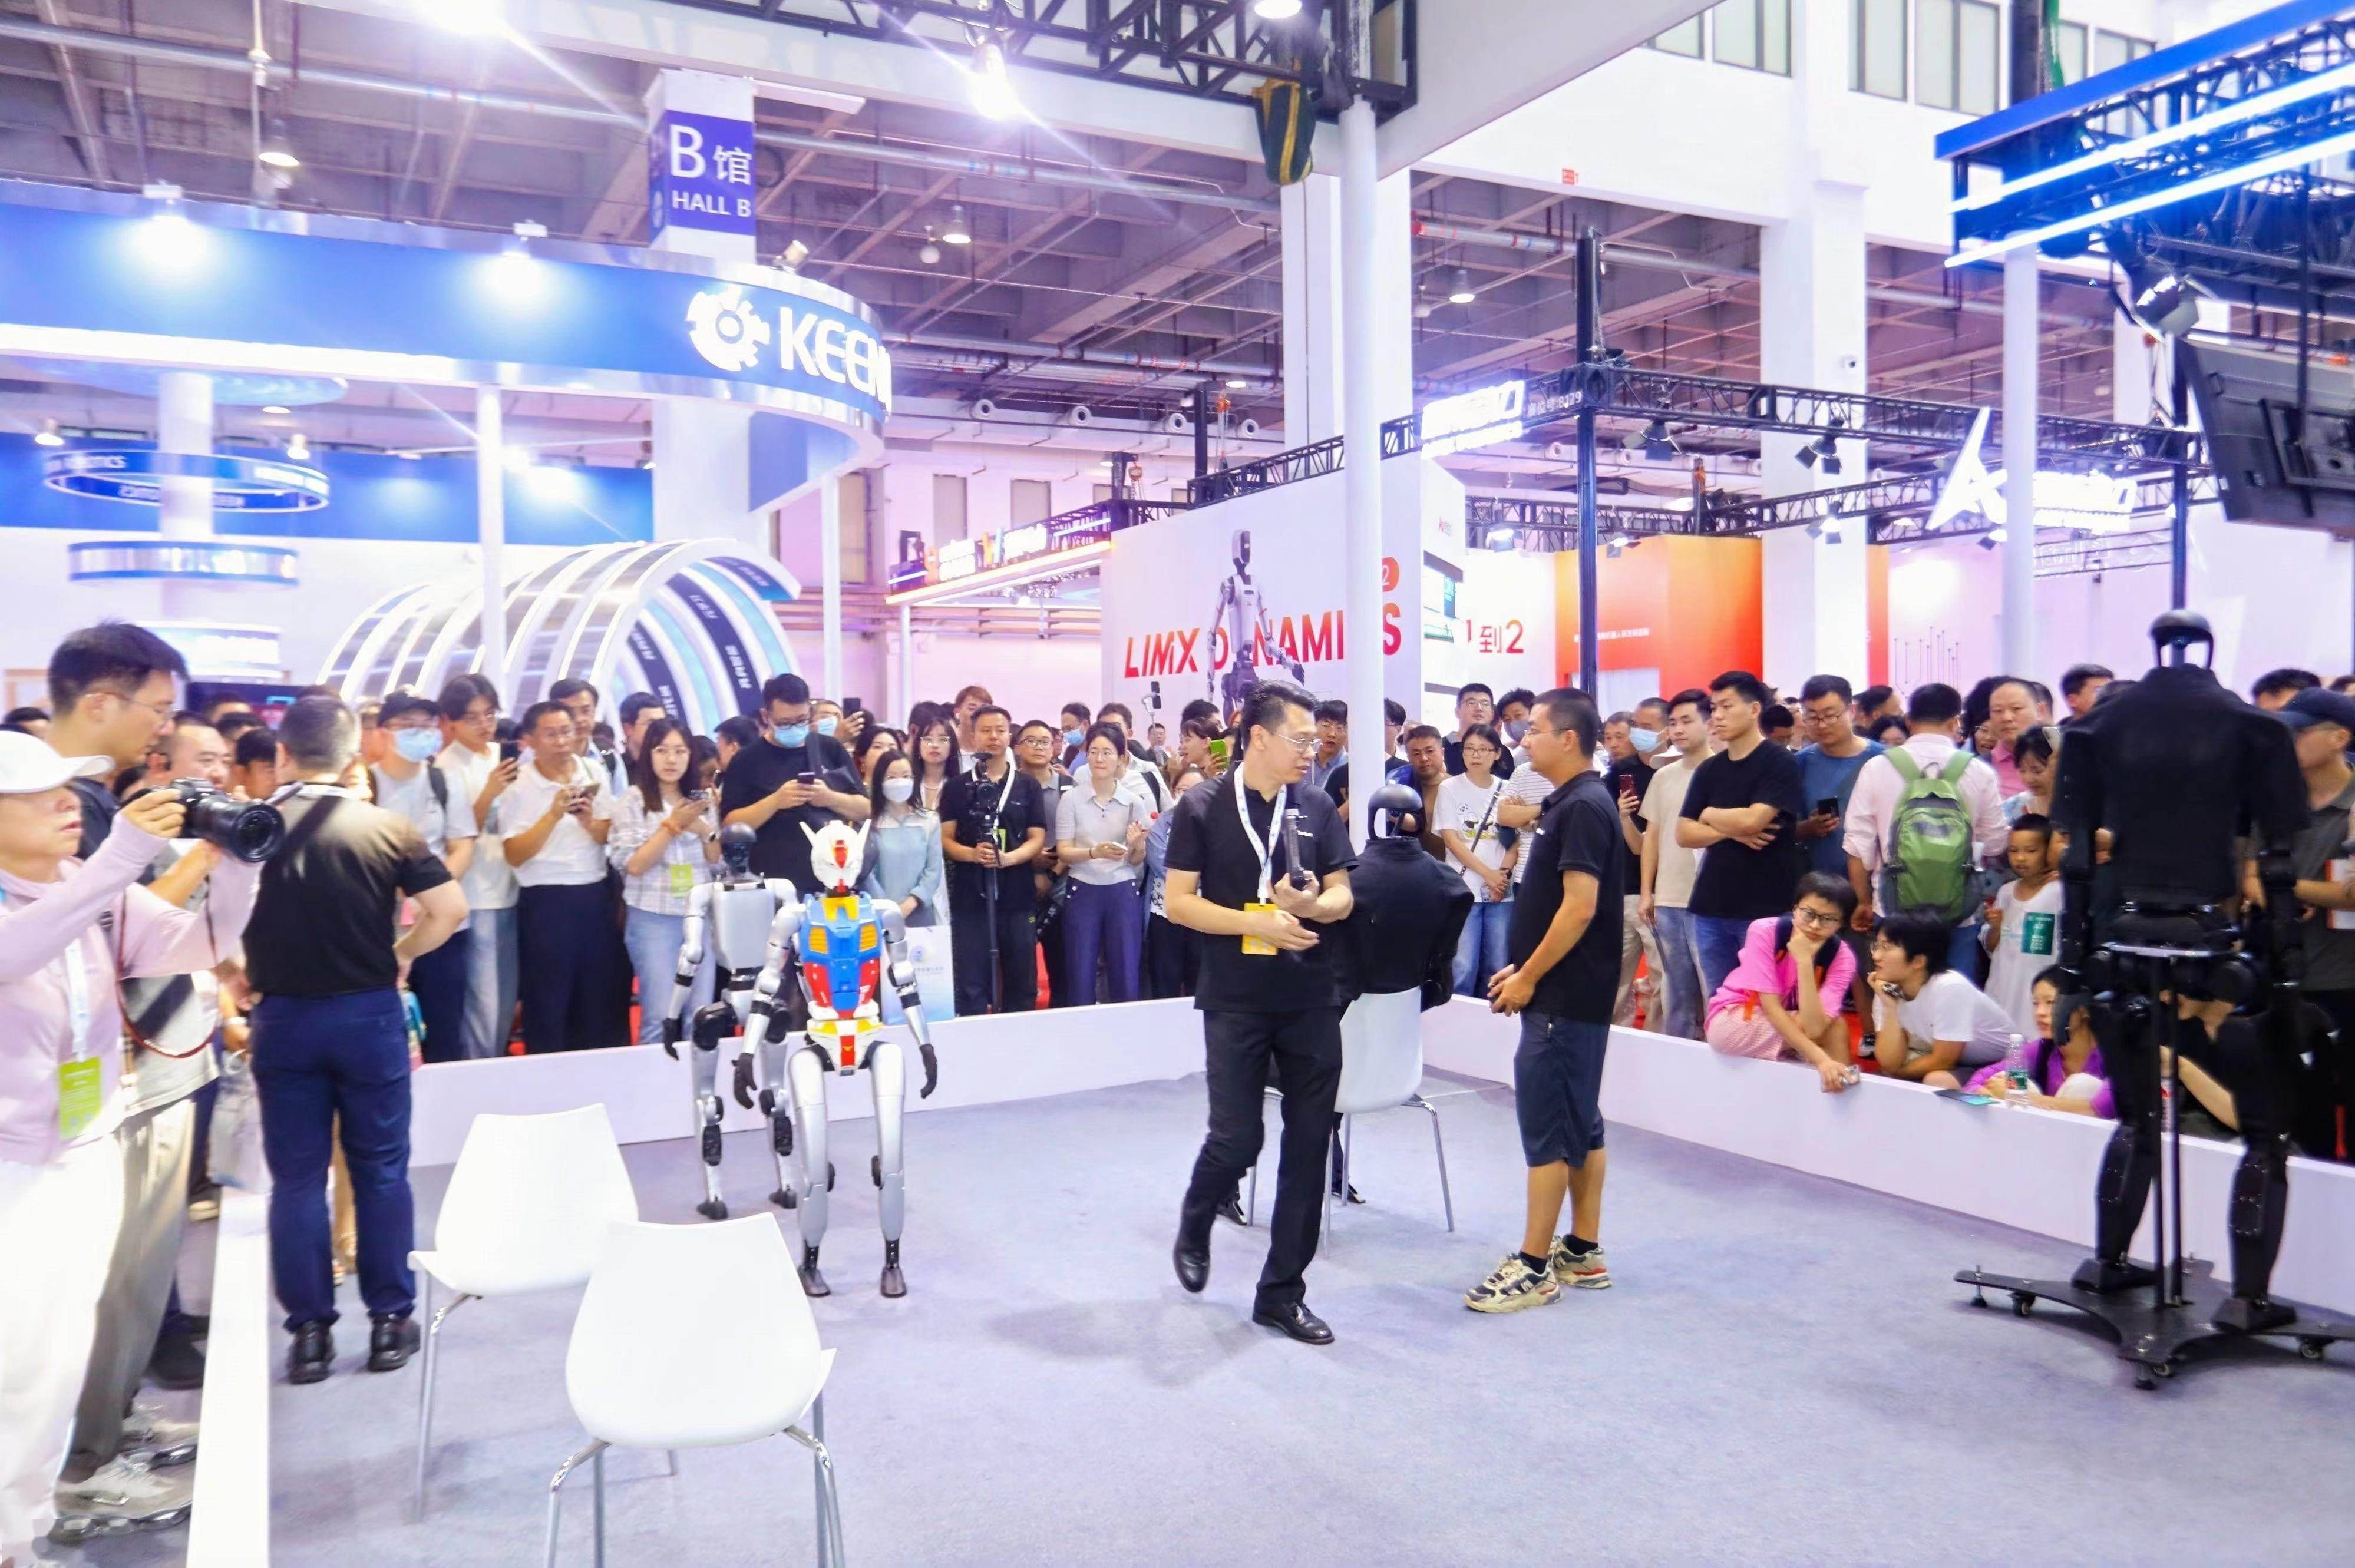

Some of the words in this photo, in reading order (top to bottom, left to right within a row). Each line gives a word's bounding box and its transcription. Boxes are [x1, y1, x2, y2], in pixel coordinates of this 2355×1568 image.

[669, 124, 752, 185] B馆
[672, 190, 731, 216] HALL
[737, 199, 752, 217] B
[780, 307, 892, 415] KEEN
[1124, 628, 1200, 679] LIMX
[1213, 602, 1402, 670] DNAMIS
